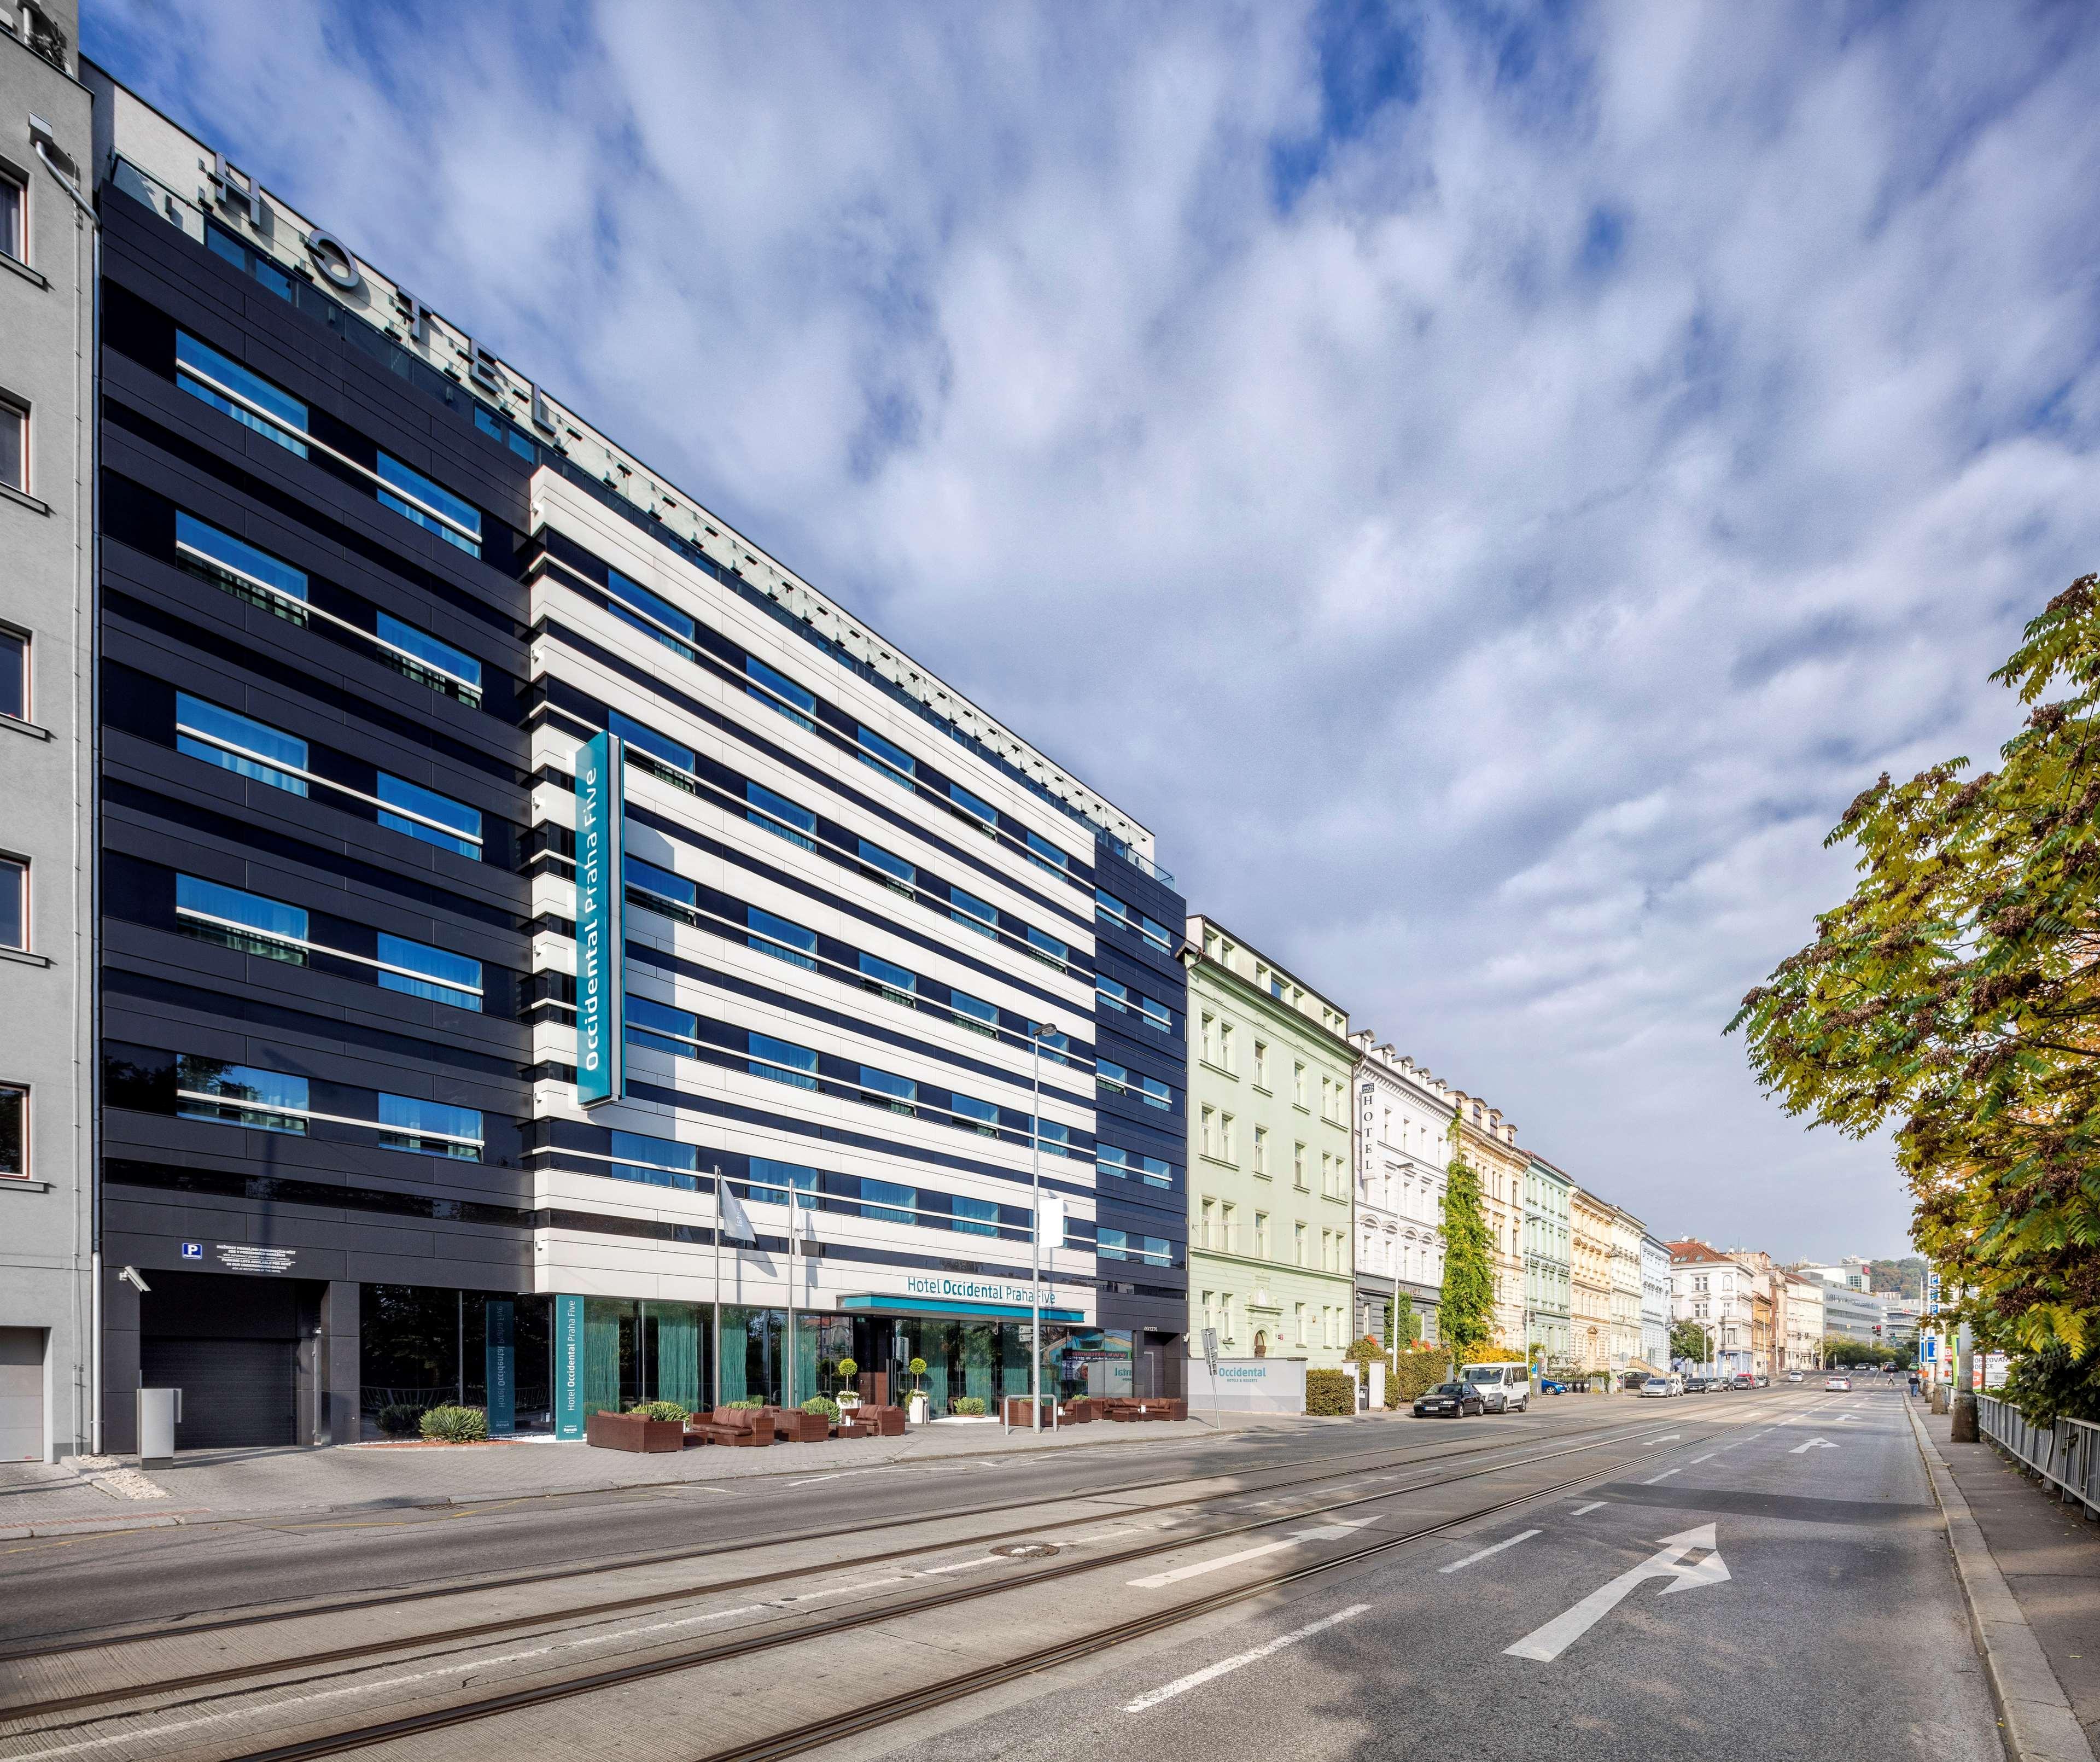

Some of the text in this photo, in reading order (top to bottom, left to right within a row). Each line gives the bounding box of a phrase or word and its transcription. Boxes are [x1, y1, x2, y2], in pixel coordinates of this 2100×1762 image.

[215, 151, 557, 436] HOTEL
[584, 767, 598, 1071] Occidental Praha Five
[1364, 1095, 1373, 1170] HOTEL
[188, 1245, 198, 1255] P
[908, 1277, 941, 1294] Hotel
[943, 1280, 1002, 1299] Occidental
[1006, 1287, 1034, 1302] Praha
[567, 1300, 576, 1410] Hotel Occidental Praha Five
[1219, 1367, 1266, 1377] Occidental
